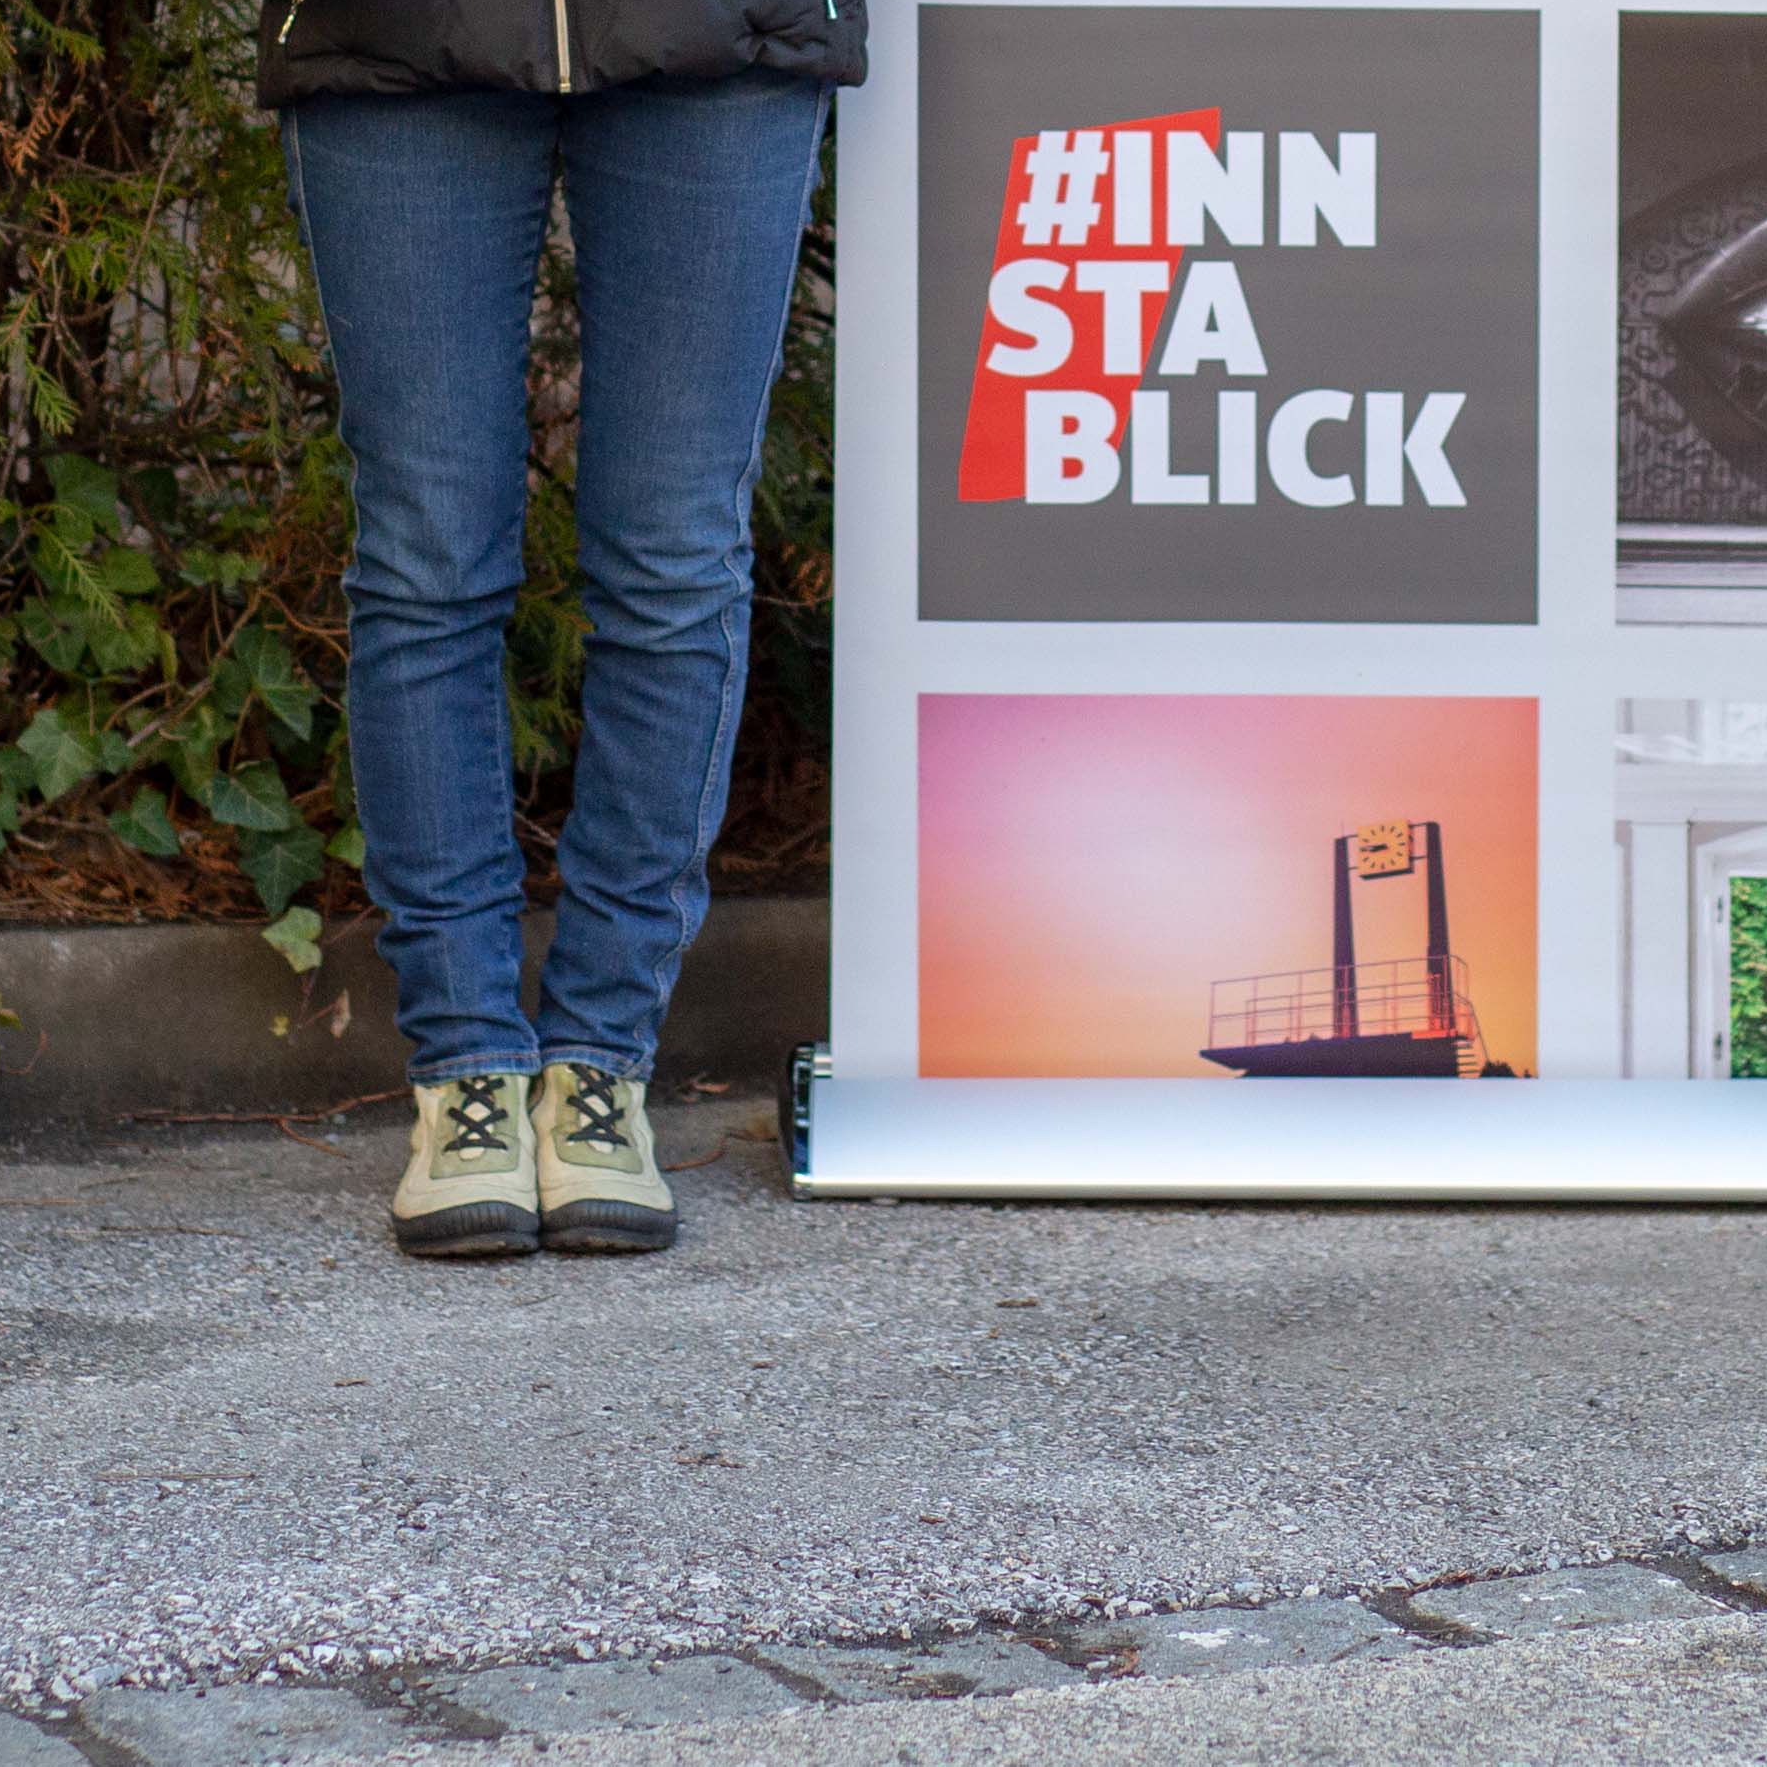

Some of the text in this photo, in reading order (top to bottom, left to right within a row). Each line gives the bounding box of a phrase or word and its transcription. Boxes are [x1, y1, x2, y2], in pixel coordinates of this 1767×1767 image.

[1016, 130, 1377, 248] #INN
[984, 258, 1269, 377] STA
[1024, 388, 1468, 508] BLICK
